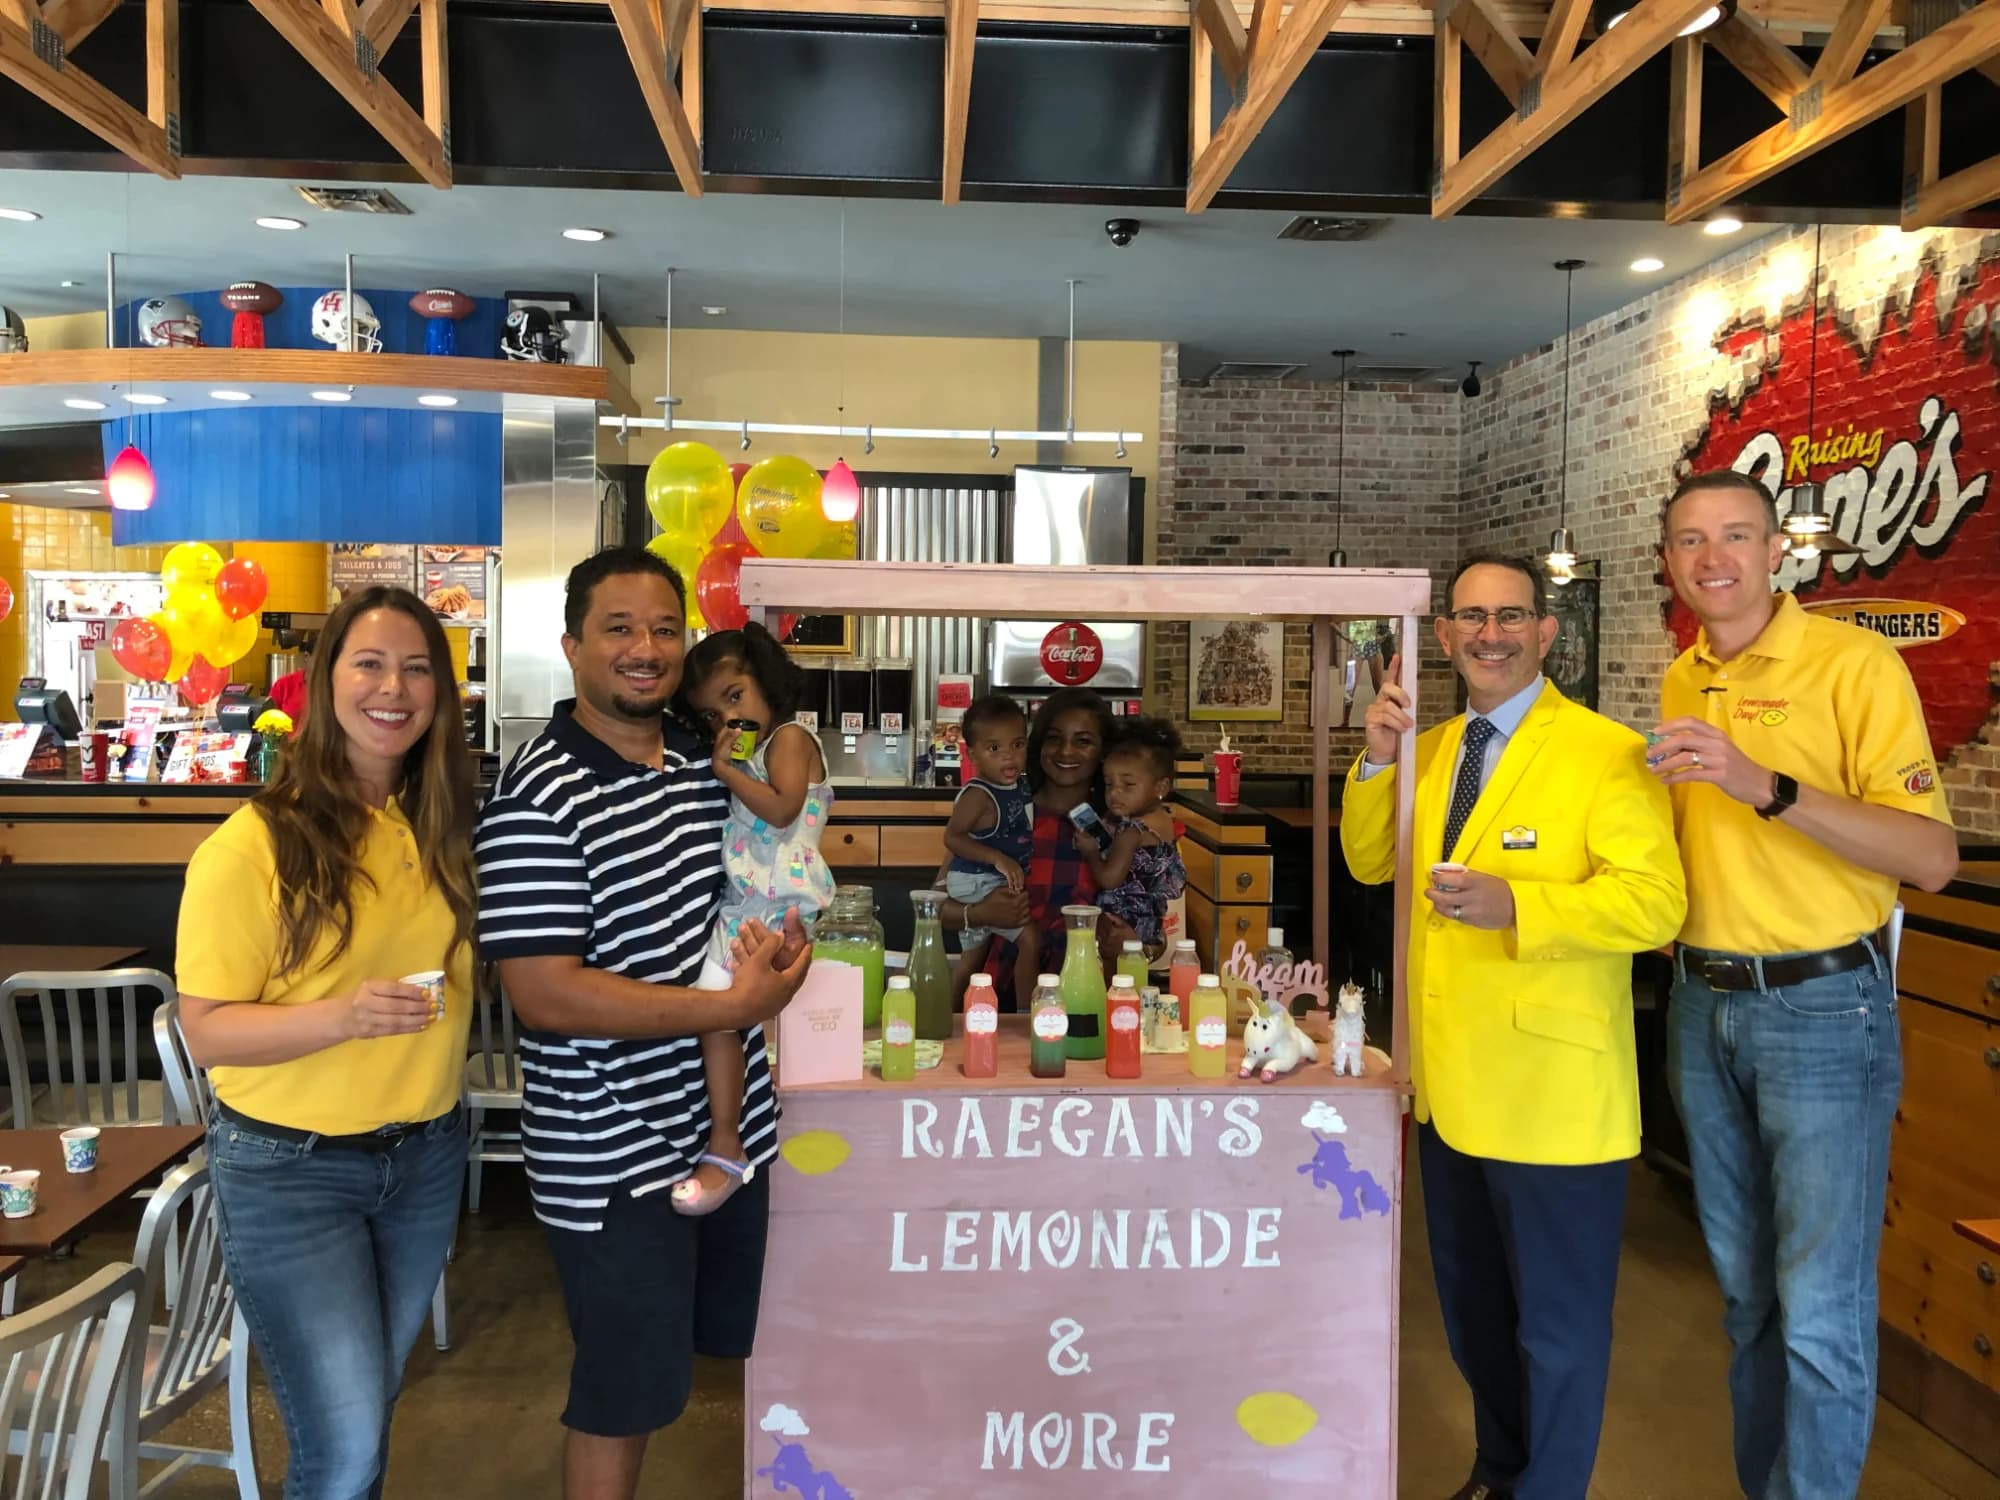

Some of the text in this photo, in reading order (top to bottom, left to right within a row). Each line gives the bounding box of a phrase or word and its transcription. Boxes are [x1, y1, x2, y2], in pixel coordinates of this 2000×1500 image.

[1786, 424, 1885, 481] Raising
[1730, 397, 1989, 593] ane's
[1854, 611, 1940, 638] FINGERS
[1046, 644, 1097, 663] Coca-Cola
[843, 718, 861, 729] TEA
[882, 718, 900, 729] TEA
[1737, 695, 1790, 709] Lemonade
[1221, 939, 1329, 987] dream
[901, 1096, 1264, 1158] RAEGAN'S
[889, 1207, 1282, 1273] LEMONADE
[1047, 1317, 1091, 1376] &
[980, 1410, 1176, 1473] MORE
